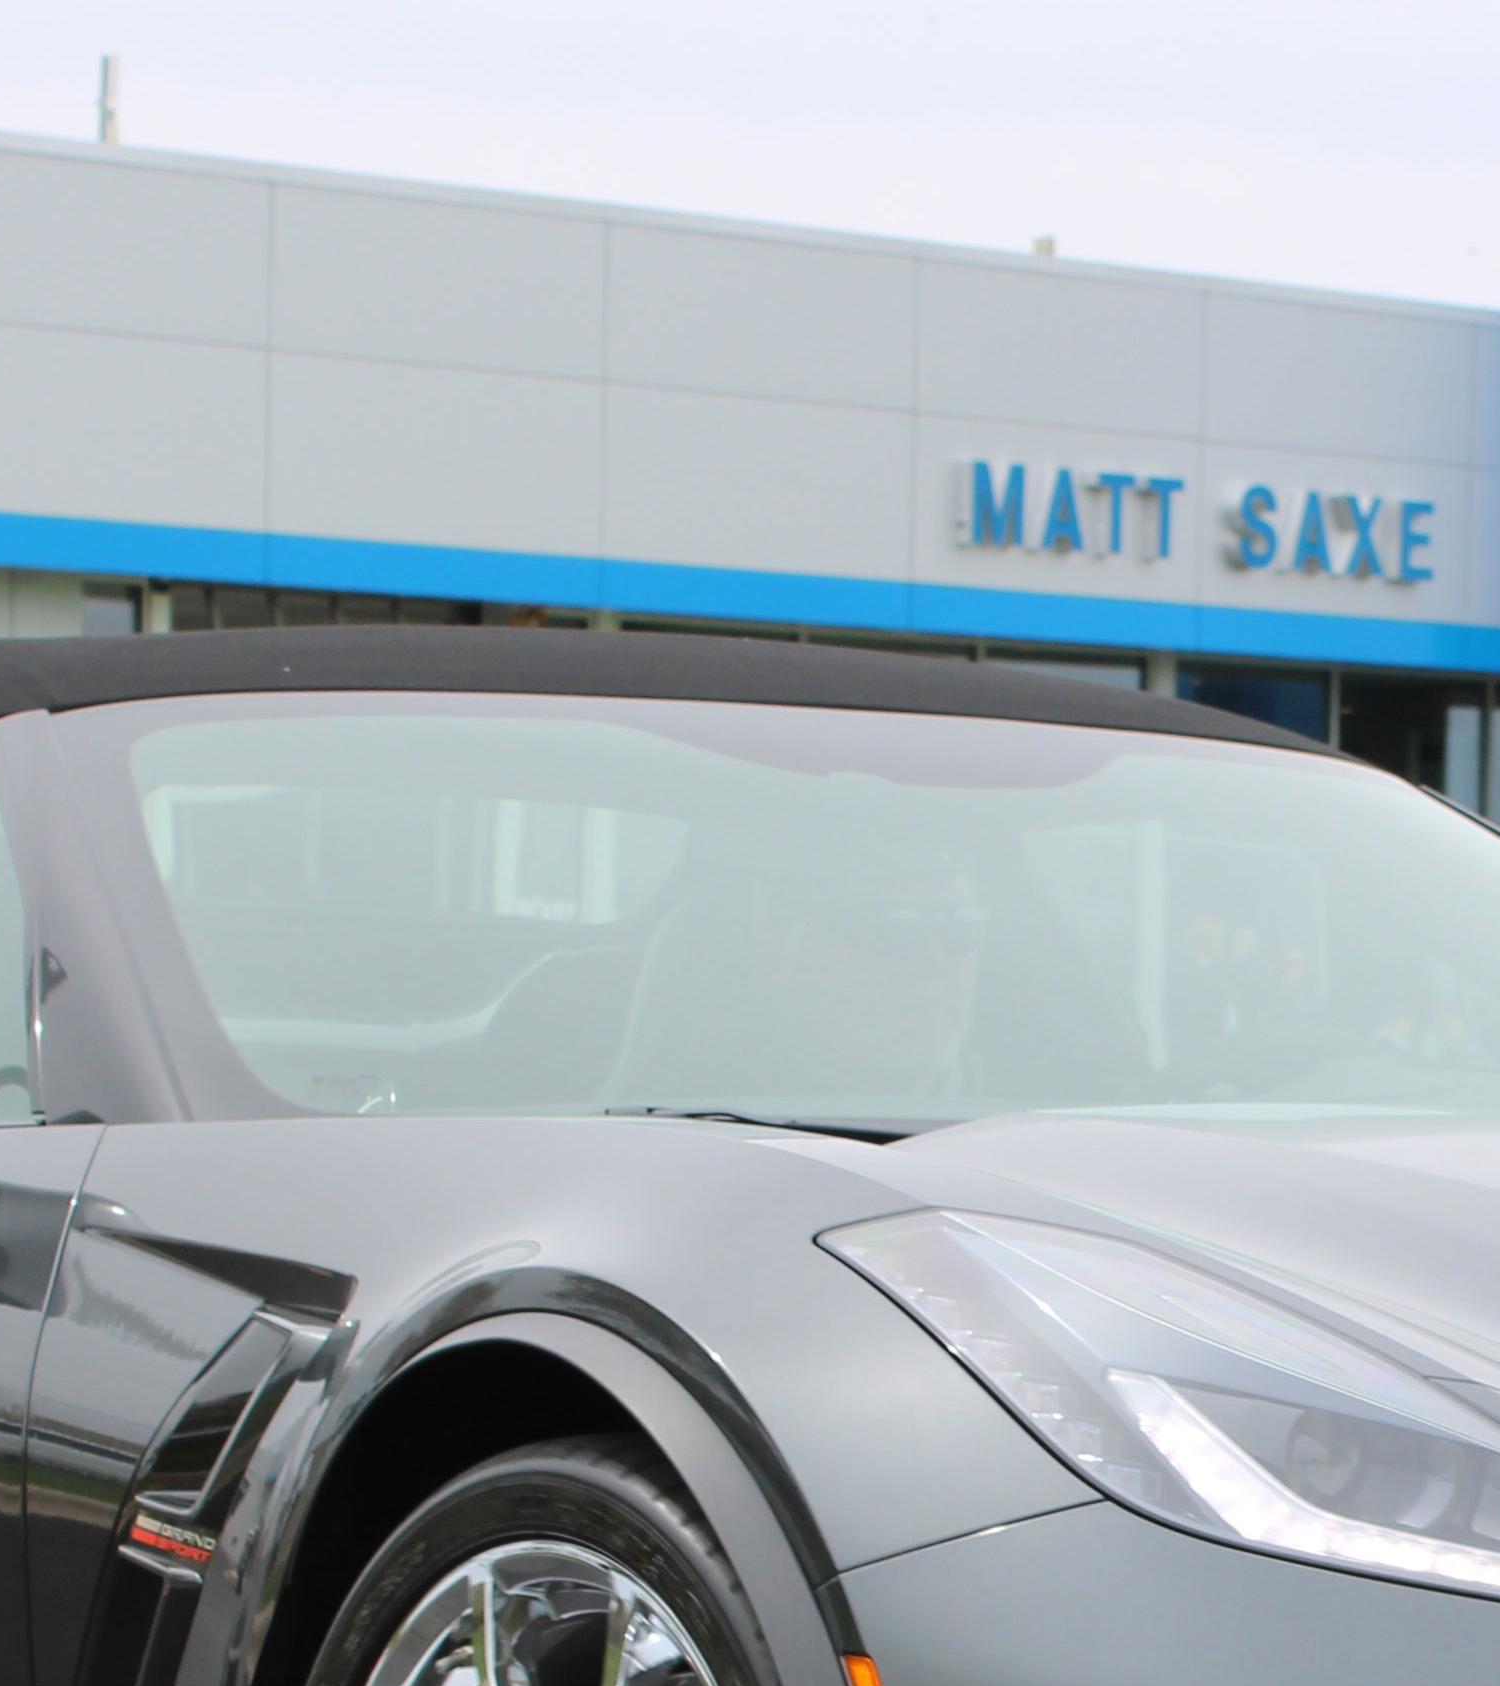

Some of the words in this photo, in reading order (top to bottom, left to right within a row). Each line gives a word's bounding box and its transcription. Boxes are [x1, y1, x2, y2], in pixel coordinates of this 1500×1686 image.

[972, 459, 1184, 558] MATT
[1238, 484, 1435, 581] SAXE
[160, 1522, 217, 1551] GRAND
